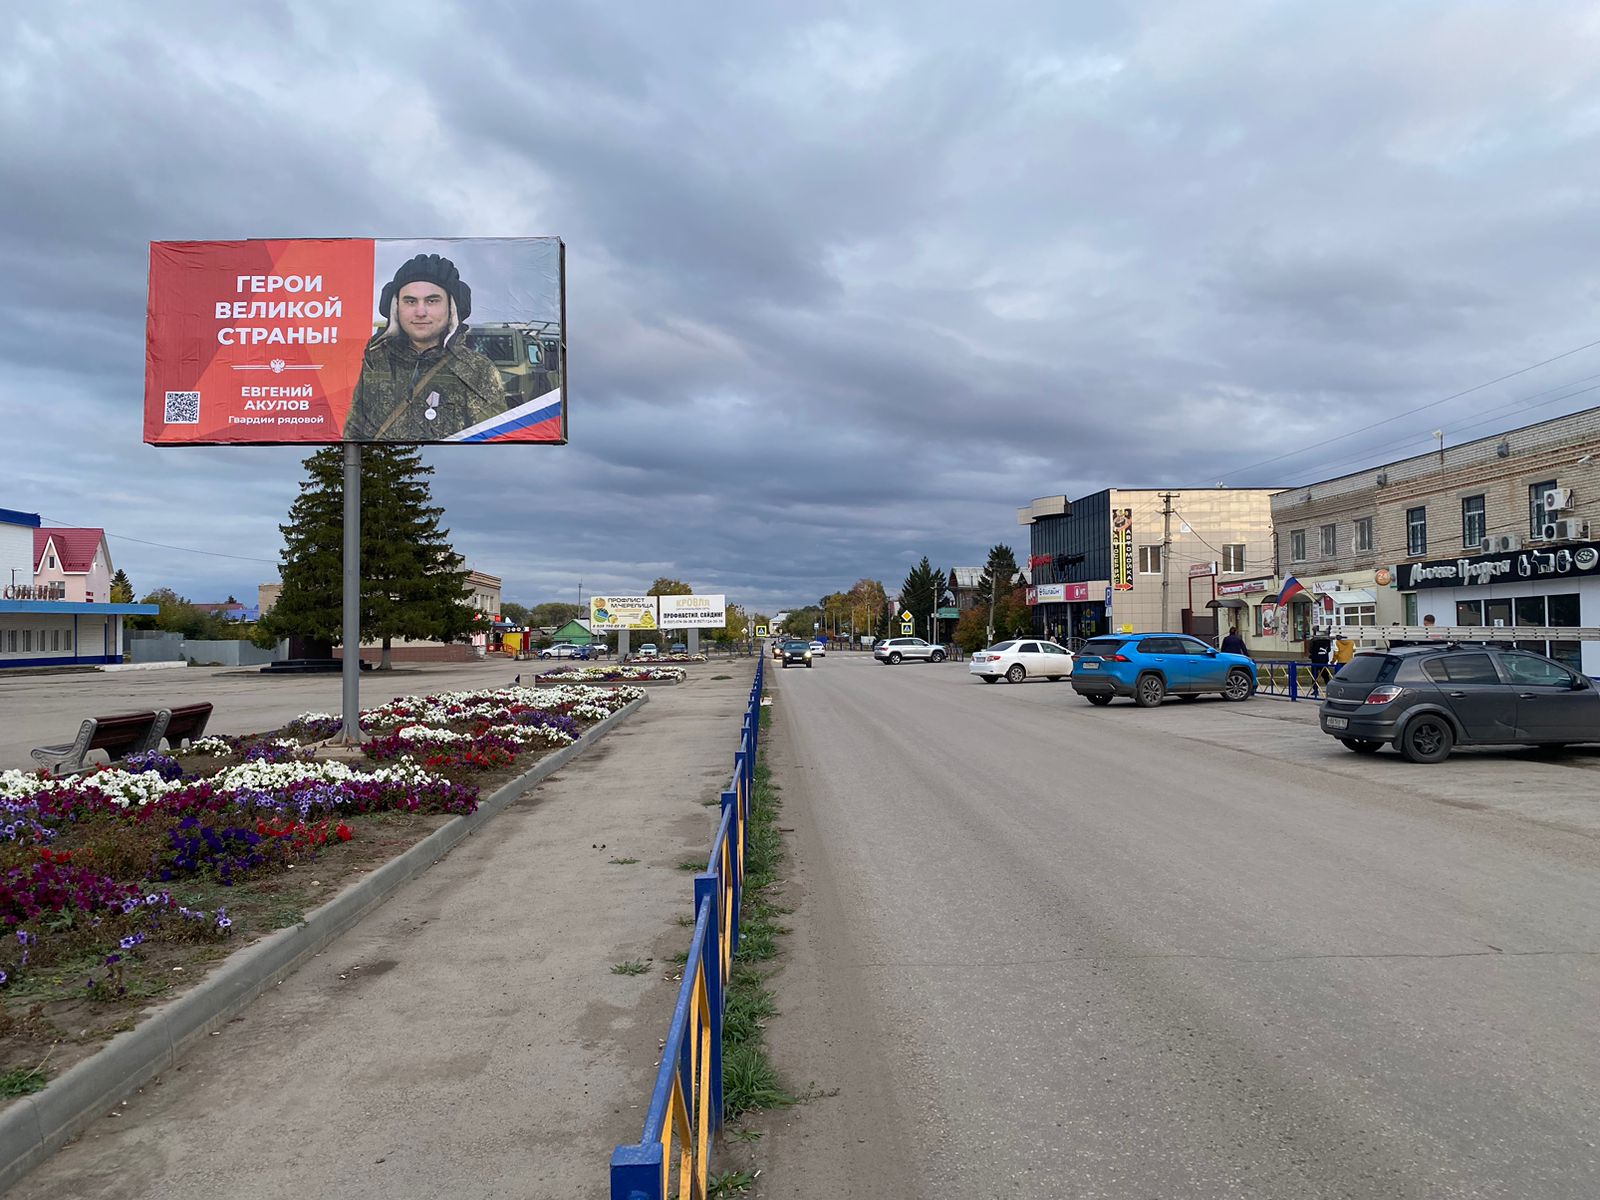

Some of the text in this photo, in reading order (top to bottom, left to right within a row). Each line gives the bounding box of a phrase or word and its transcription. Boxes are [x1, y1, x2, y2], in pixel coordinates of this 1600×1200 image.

[237, 275, 323, 293] ГЕРОИ
[215, 296, 342, 319] ВЕЛИКОЙ
[217, 326, 338, 345] СТРАНЫ!
[241, 383, 313, 397] ЕВГЕНИЙ
[244, 400, 310, 411] АКУЛОВ
[228, 414, 324, 425] Гвардии рядовой
[1125, 529, 1133, 581] АВТОМОЙКА
